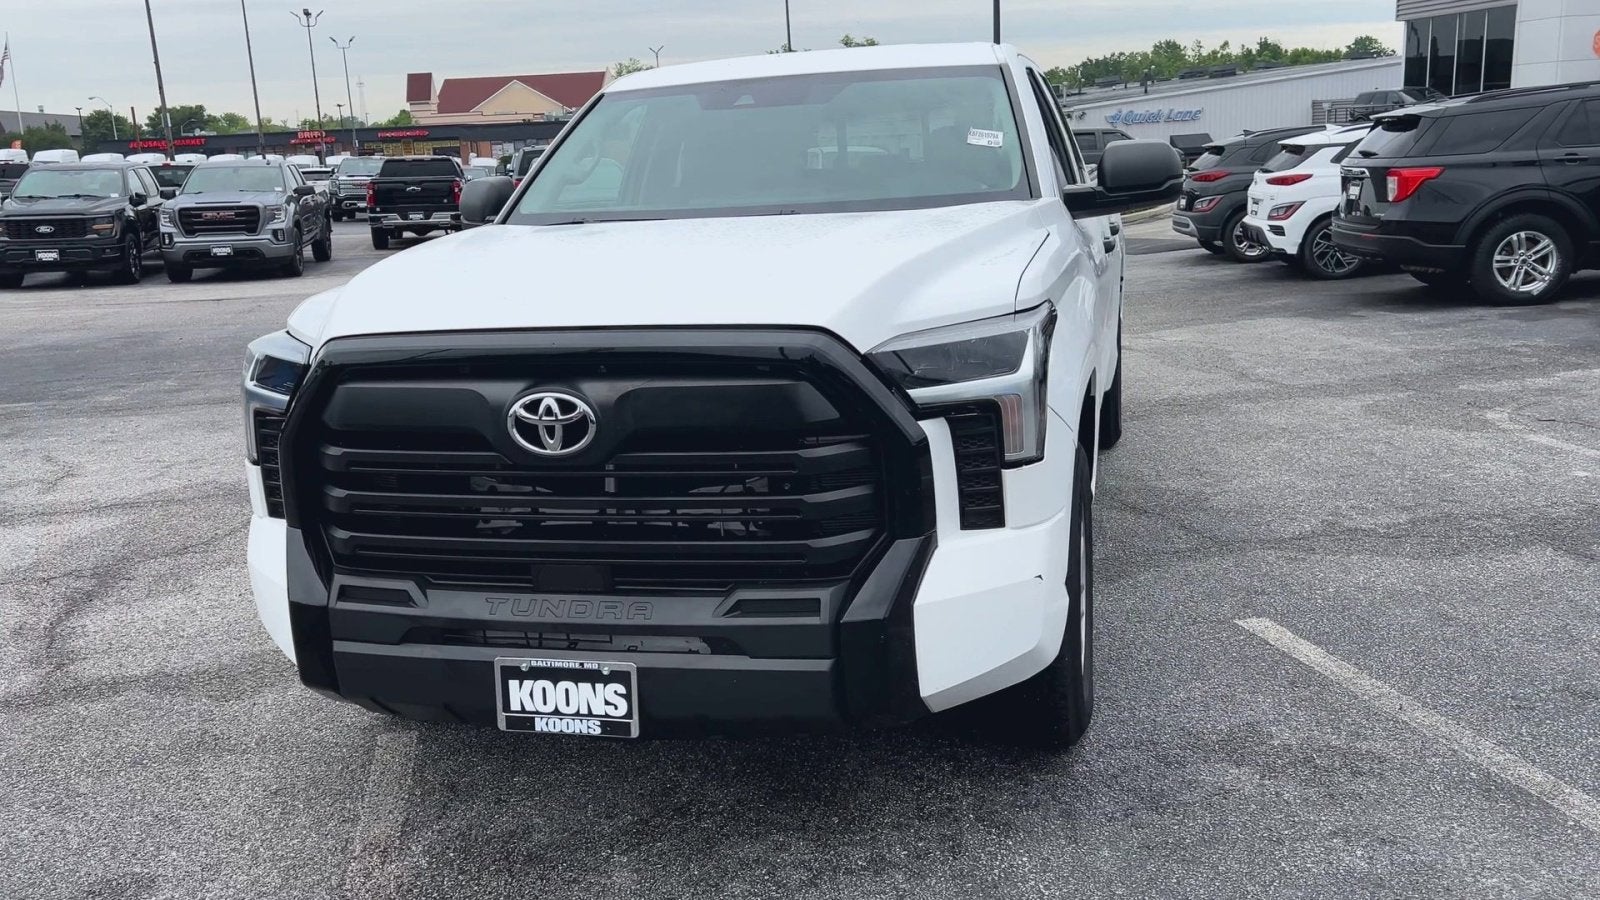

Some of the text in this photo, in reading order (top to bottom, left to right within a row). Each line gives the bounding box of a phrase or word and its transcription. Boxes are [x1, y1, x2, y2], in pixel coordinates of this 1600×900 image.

[1122, 108, 1201, 125] Quick Lane
[485, 597, 654, 620] TUNDRA
[508, 679, 628, 717] KOONS
[534, 716, 602, 735] KOONS
